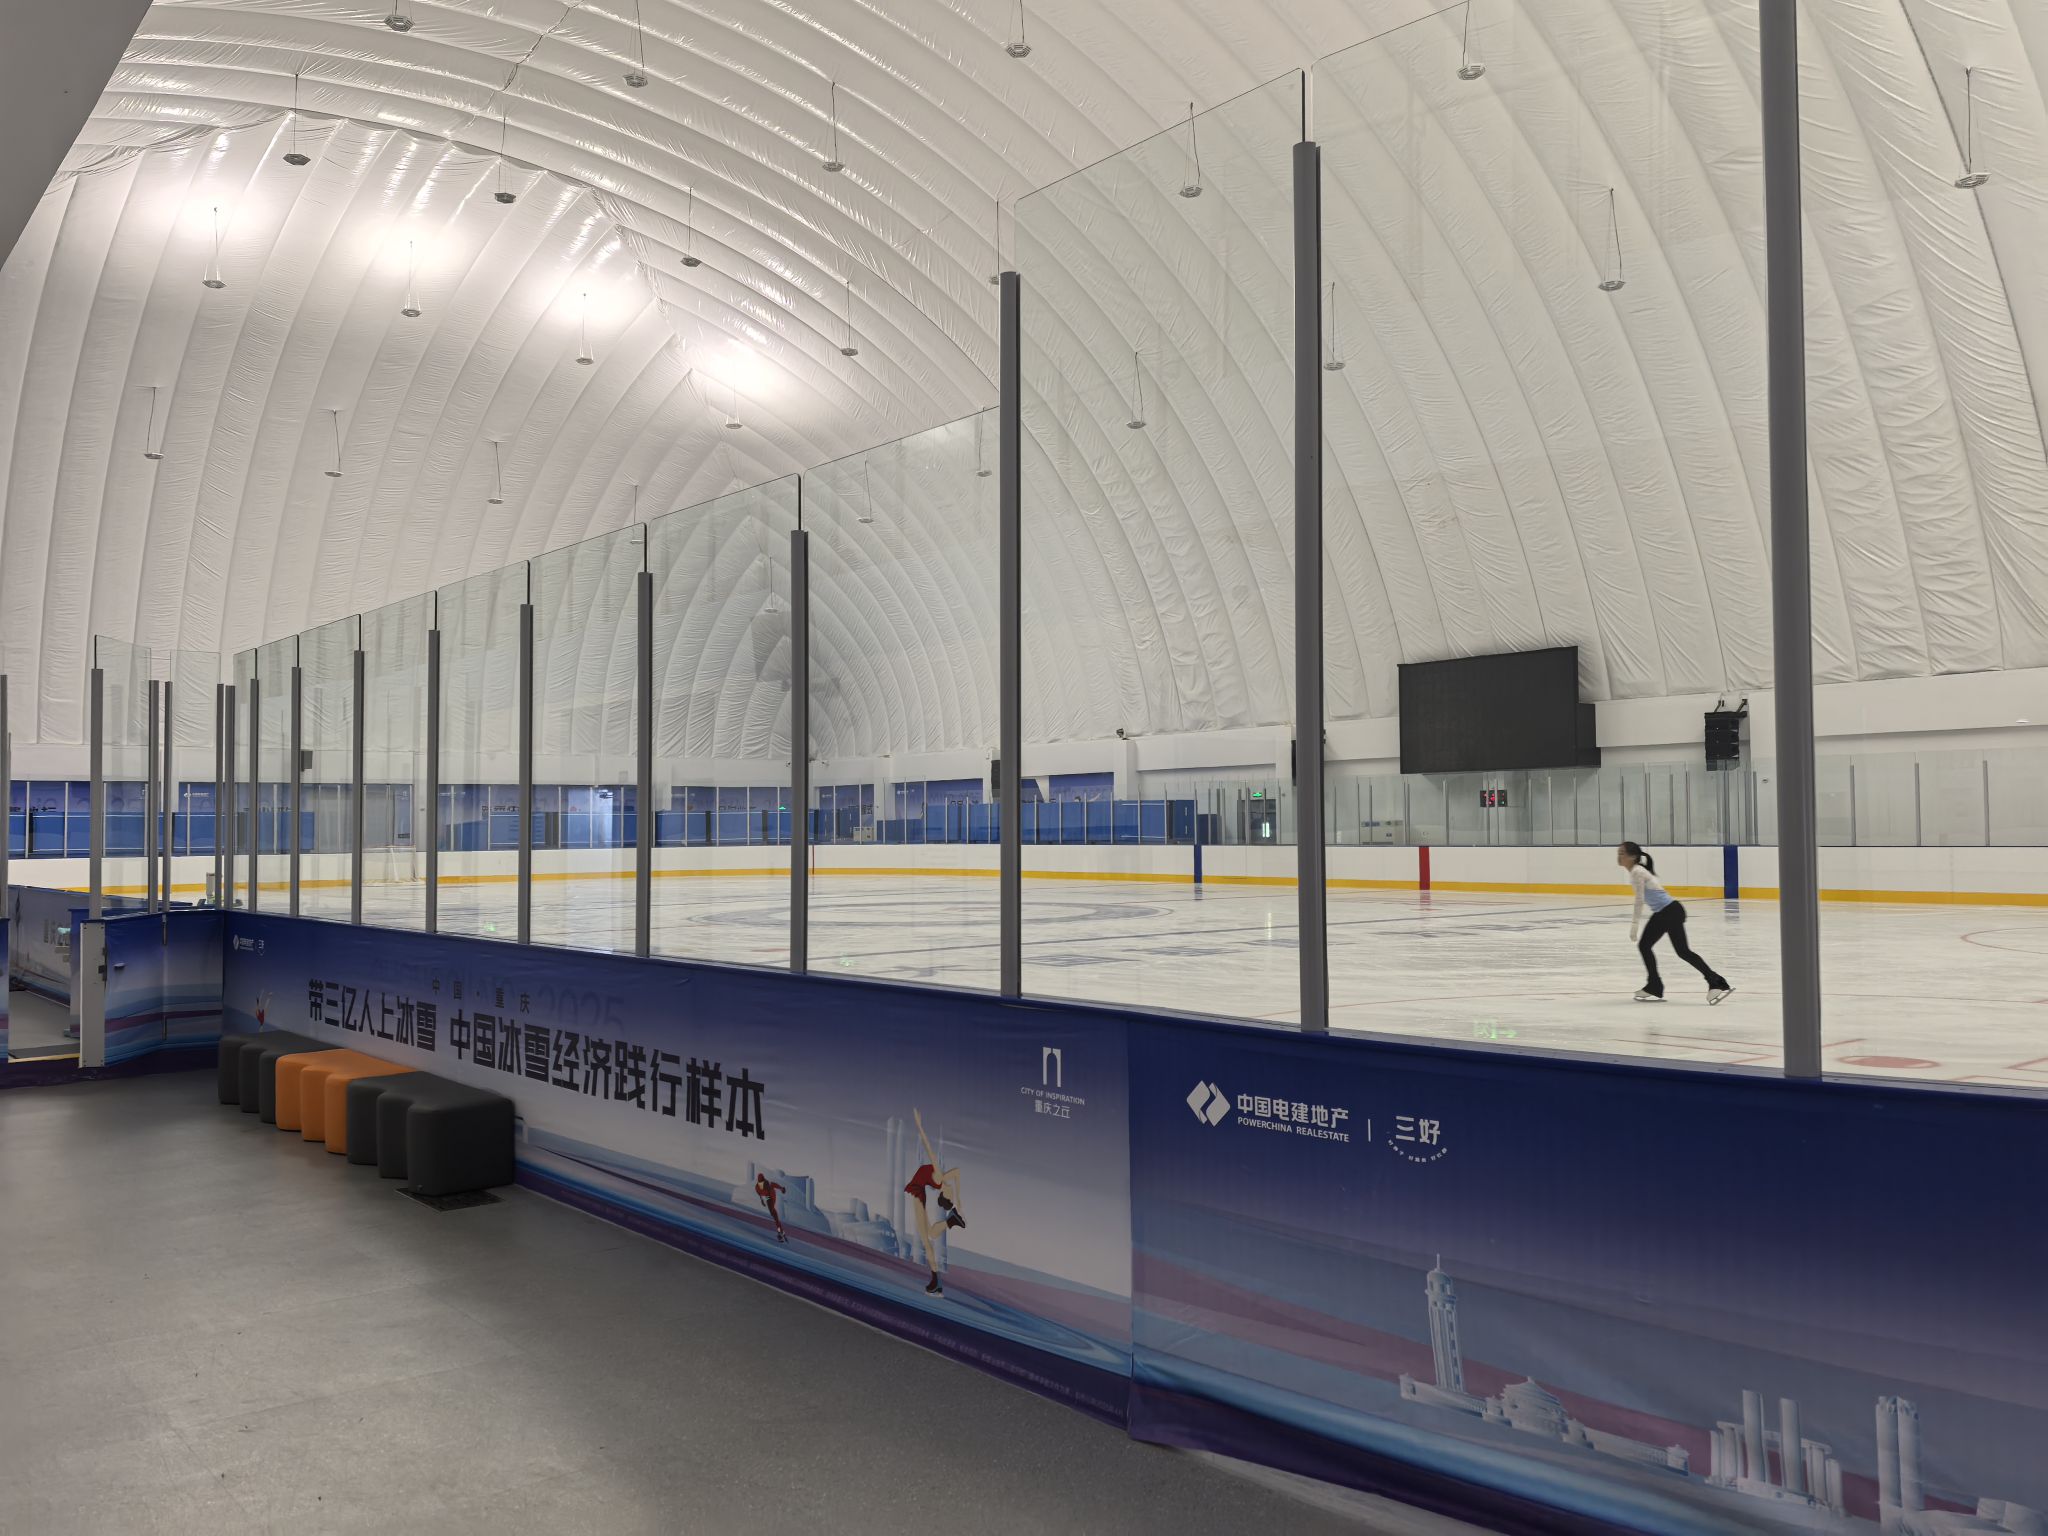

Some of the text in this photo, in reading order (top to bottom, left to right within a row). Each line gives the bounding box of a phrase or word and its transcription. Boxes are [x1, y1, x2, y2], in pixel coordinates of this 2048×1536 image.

[308, 978, 765, 1141] 带三亿人上冰雪 中国冰雪经济践行样本
[1020, 1086, 1085, 1105] CITY OF INSPIRATION
[1237, 1093, 1349, 1129] 中国电建地产
[1237, 1116, 1350, 1143] POWERCHINA REALESTATE
[1395, 1115, 1441, 1146] 三好
